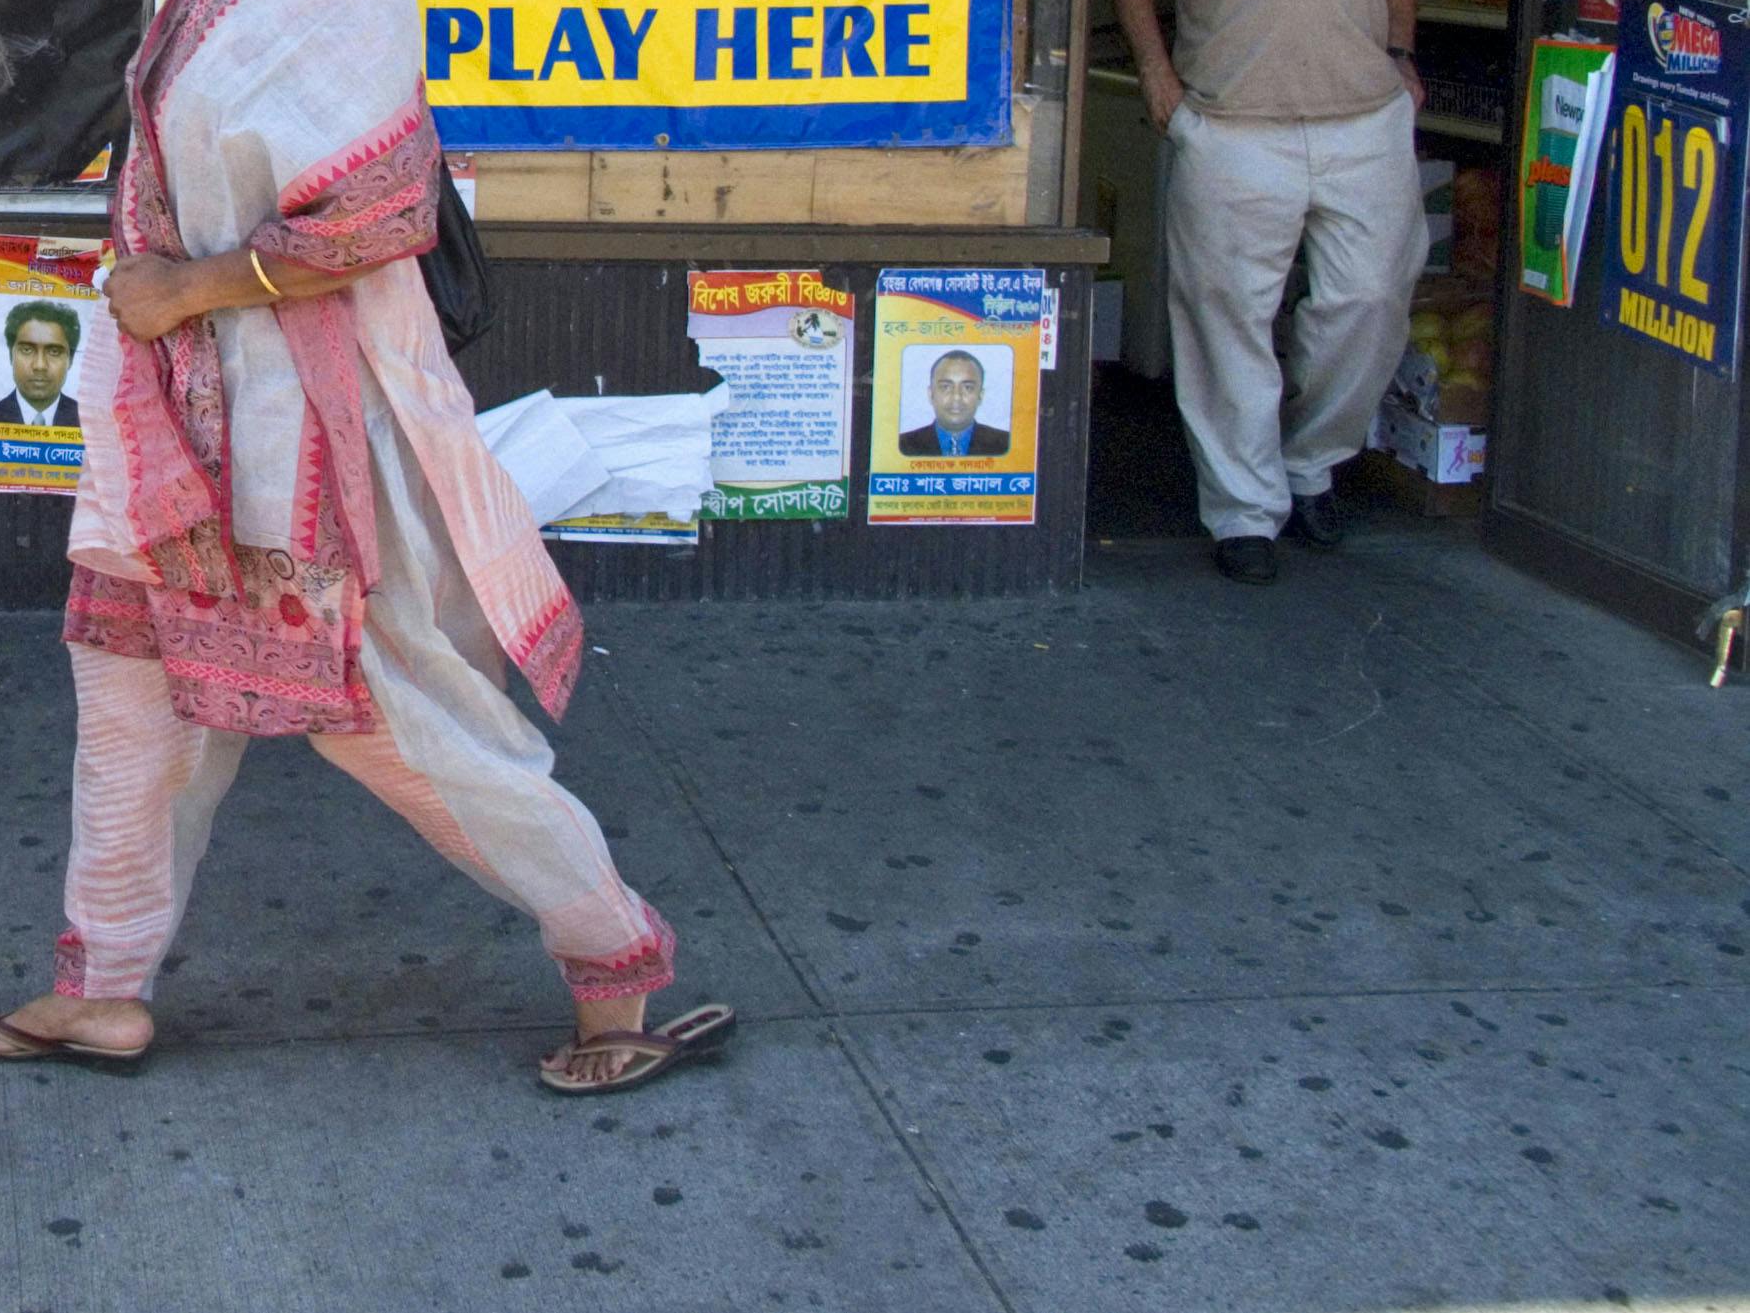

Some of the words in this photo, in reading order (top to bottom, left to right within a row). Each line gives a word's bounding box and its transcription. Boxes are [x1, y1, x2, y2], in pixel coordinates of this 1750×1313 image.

[425, 4, 658, 83] PLAY
[693, 2, 932, 81] HERE
[1670, 14, 1722, 57] MEGA
[1621, 104, 1718, 305] 012
[692, 280, 740, 311] বিশেষ
[744, 272, 792, 305] জরুরী
[1618, 286, 1715, 362] MILLION
[1, 440, 41, 460] ইসলাম
[751, 483, 846, 515] সোসাইটি
[875, 476, 910, 492] মোঃ
[915, 476, 947, 494] শাহ
[951, 476, 1002, 493] জামাল
[1008, 476, 1032, 492] কে
